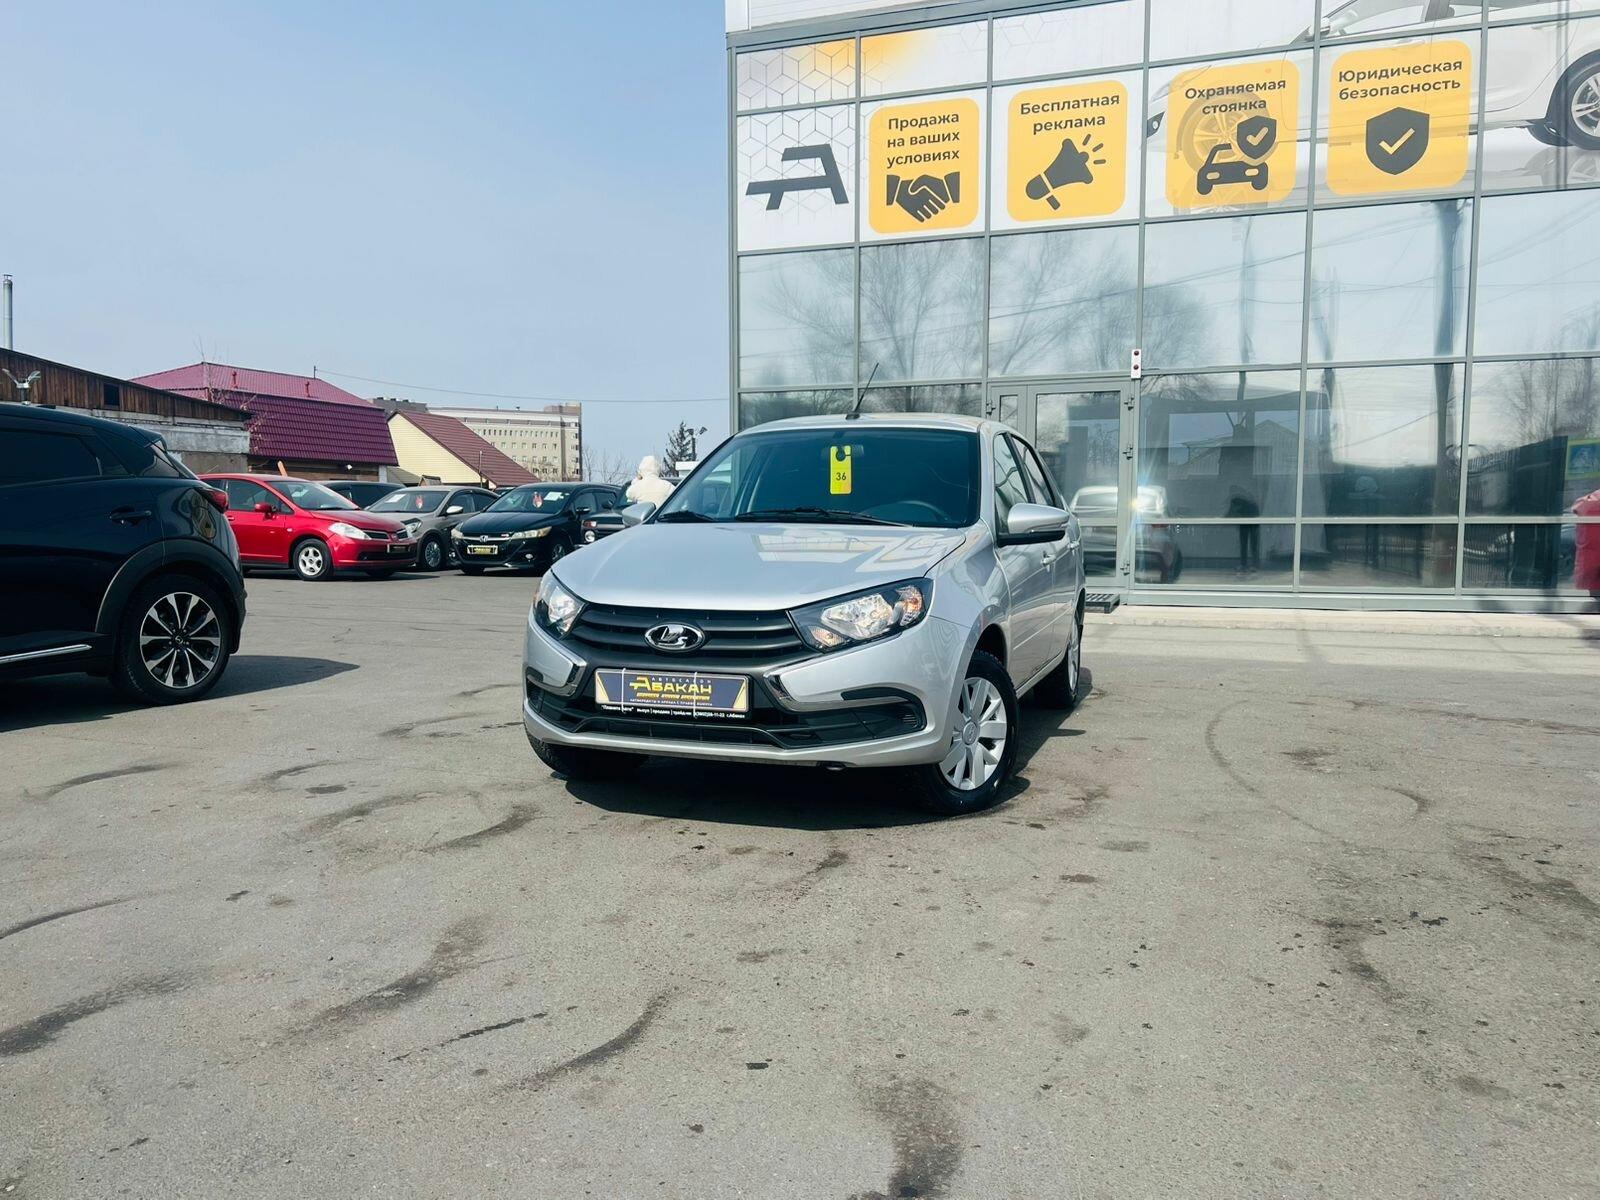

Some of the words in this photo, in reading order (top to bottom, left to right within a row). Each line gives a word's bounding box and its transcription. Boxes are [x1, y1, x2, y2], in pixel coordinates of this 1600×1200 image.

[1339, 61, 1463, 84] Юридическая
[1184, 80, 1287, 100] Охраняемая
[1339, 79, 1462, 100] безопасность
[1019, 94, 1121, 116] Бесплатная
[1202, 98, 1268, 115] стоянка
[887, 113, 961, 133] Продажа
[1033, 114, 1107, 136] реклама
[886, 137, 906, 149] на
[908, 131, 961, 147] ваших
[886, 150, 961, 170] условиях
[835, 472, 847, 481] 36
